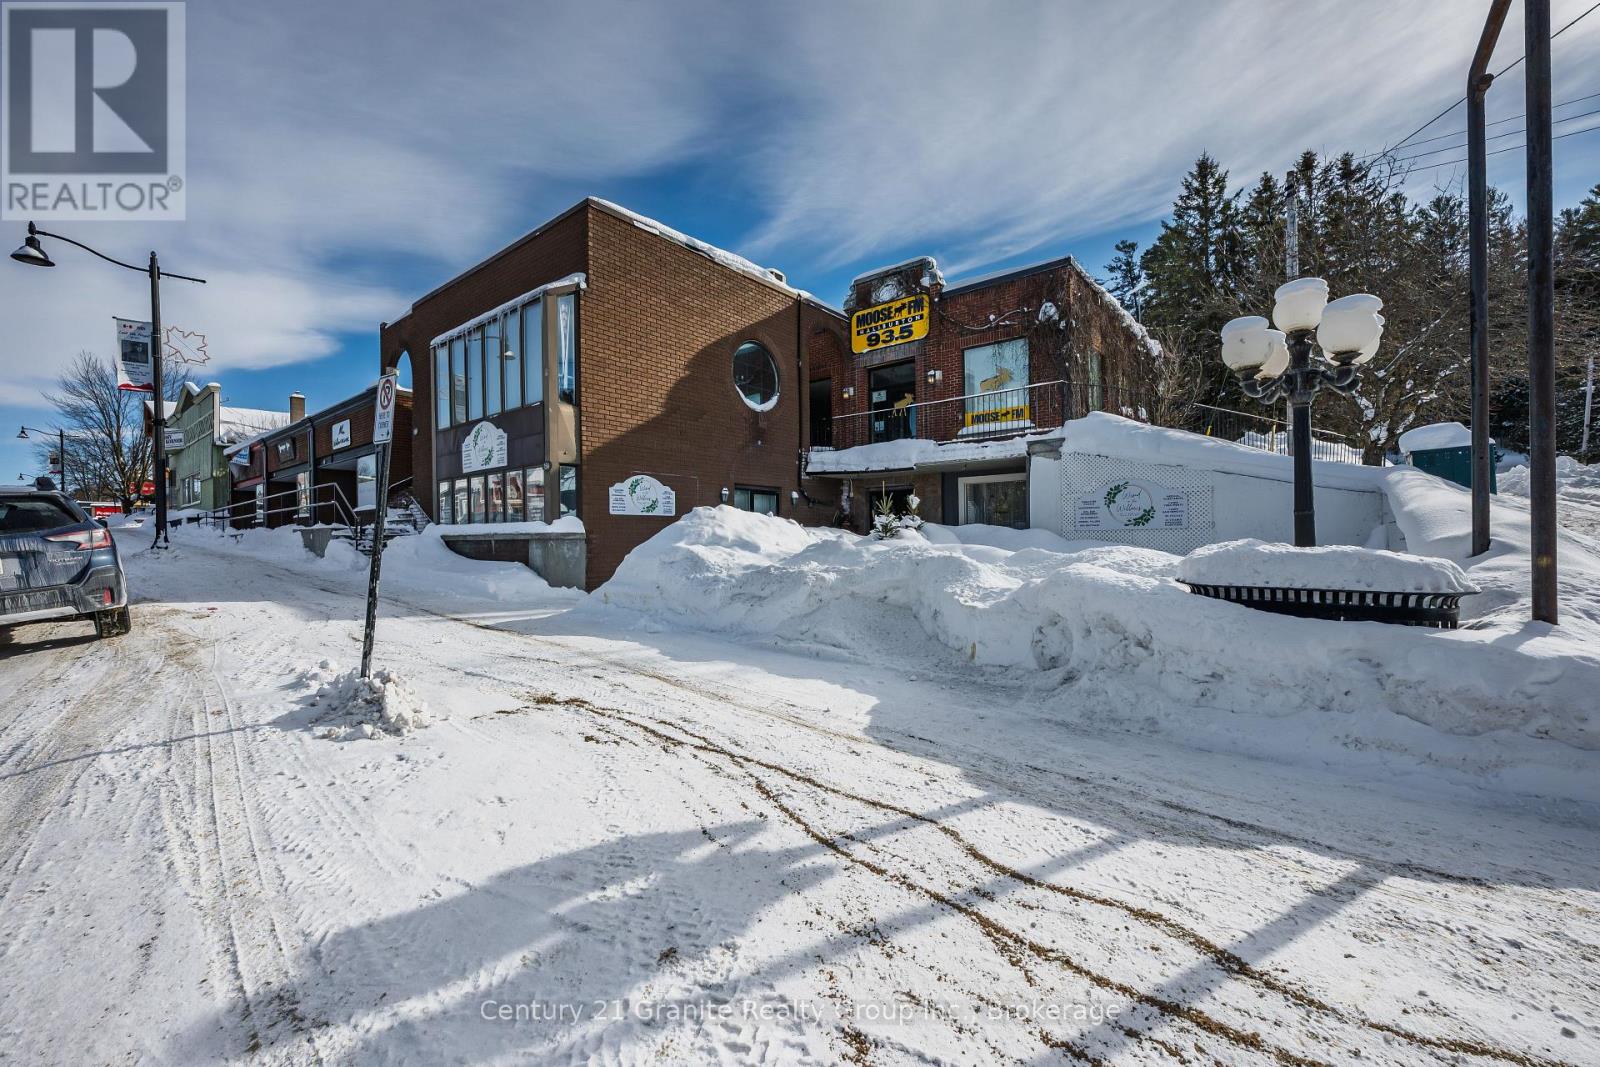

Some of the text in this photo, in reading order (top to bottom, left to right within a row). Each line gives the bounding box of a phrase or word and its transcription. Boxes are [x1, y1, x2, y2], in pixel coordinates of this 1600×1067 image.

[857, 297, 924, 329] MOOSE FM
[859, 315, 921, 335] HALIBURTON
[866, 324, 913, 347] 93.5
[971, 408, 1024, 425] MOOSE FM
